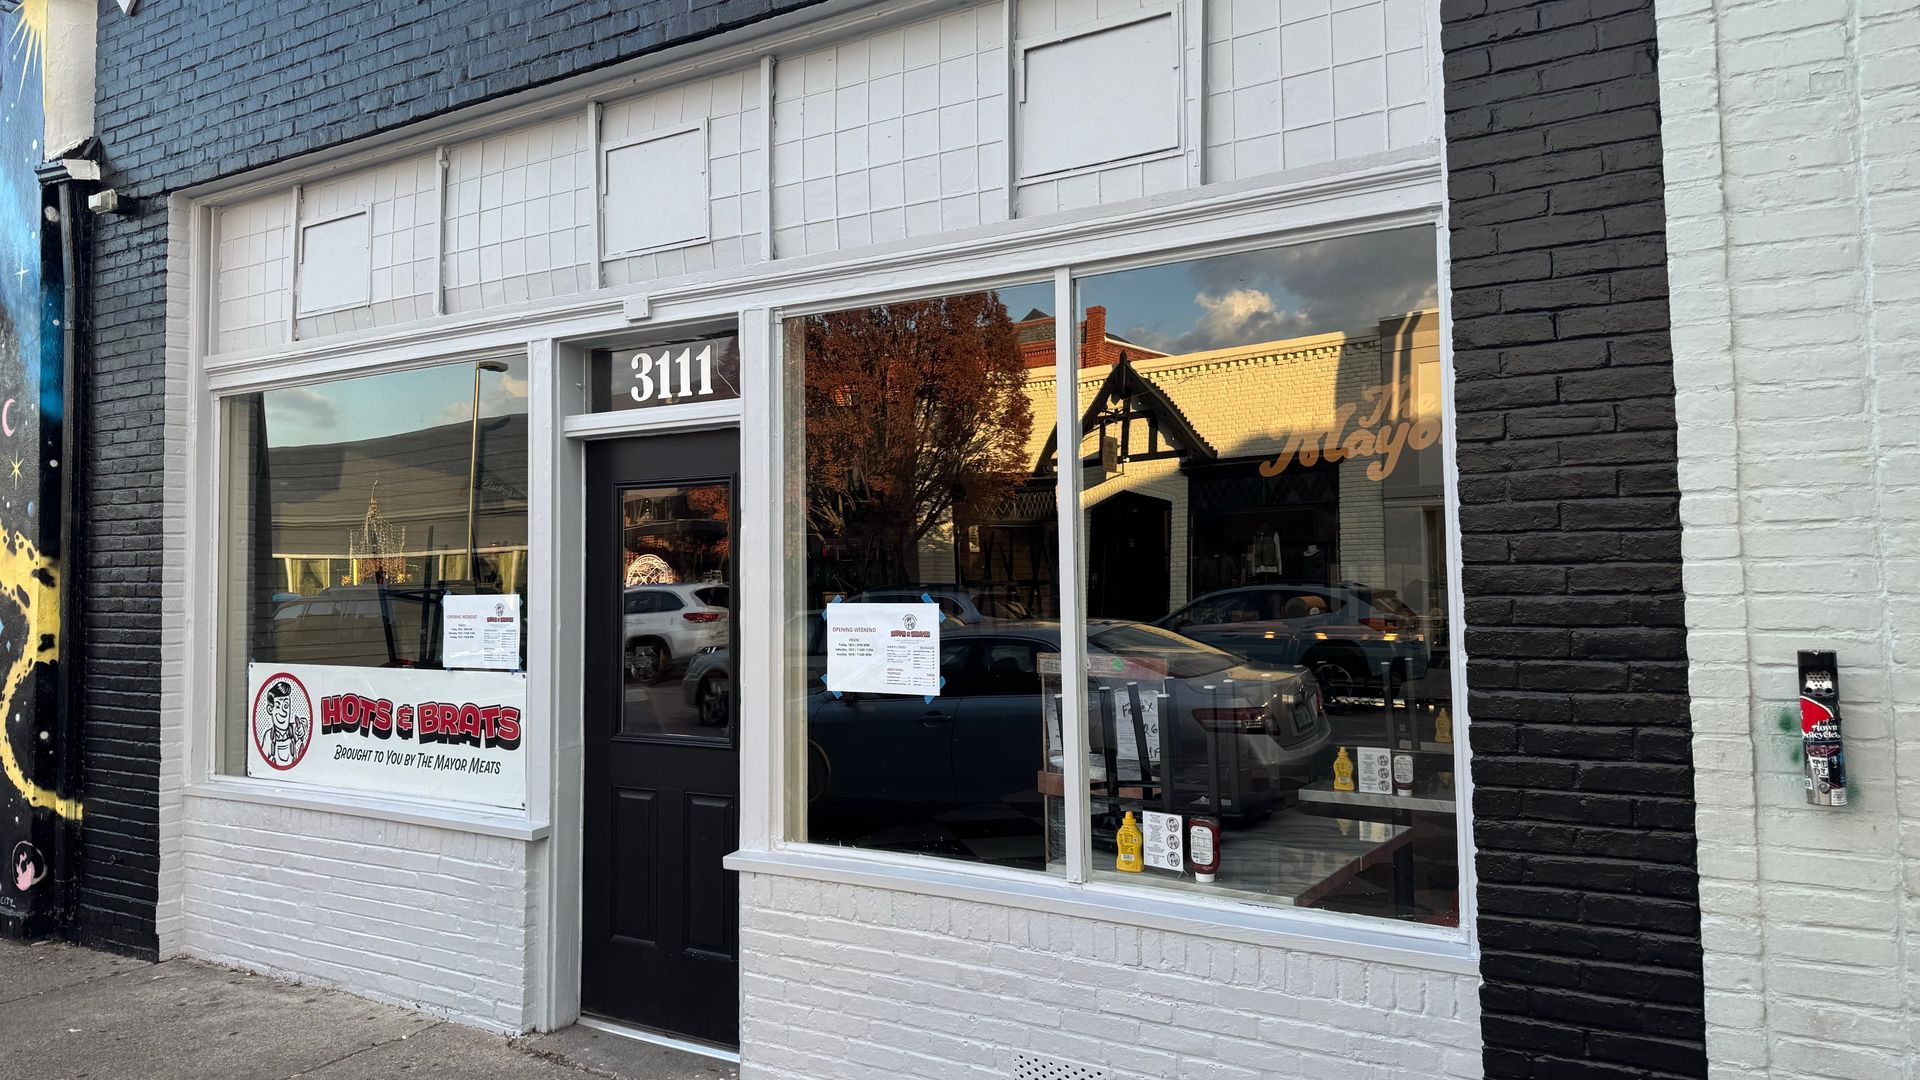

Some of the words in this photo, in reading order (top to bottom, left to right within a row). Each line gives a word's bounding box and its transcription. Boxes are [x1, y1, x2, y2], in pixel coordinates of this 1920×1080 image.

[630, 345, 713, 402] 3111
[1259, 402, 1441, 481] Mayo
[320, 693, 394, 741] HOTS
[396, 703, 415, 740] &
[417, 701, 522, 751] BRATS
[334, 744, 373, 761] BROUGHT
[373, 750, 384, 763] TO
[386, 750, 403, 765] YOU
[404, 753, 416, 767] BY
[416, 752, 434, 769] THE
[433, 754, 468, 772] MAYOR
[468, 757, 501, 775] MEATS
